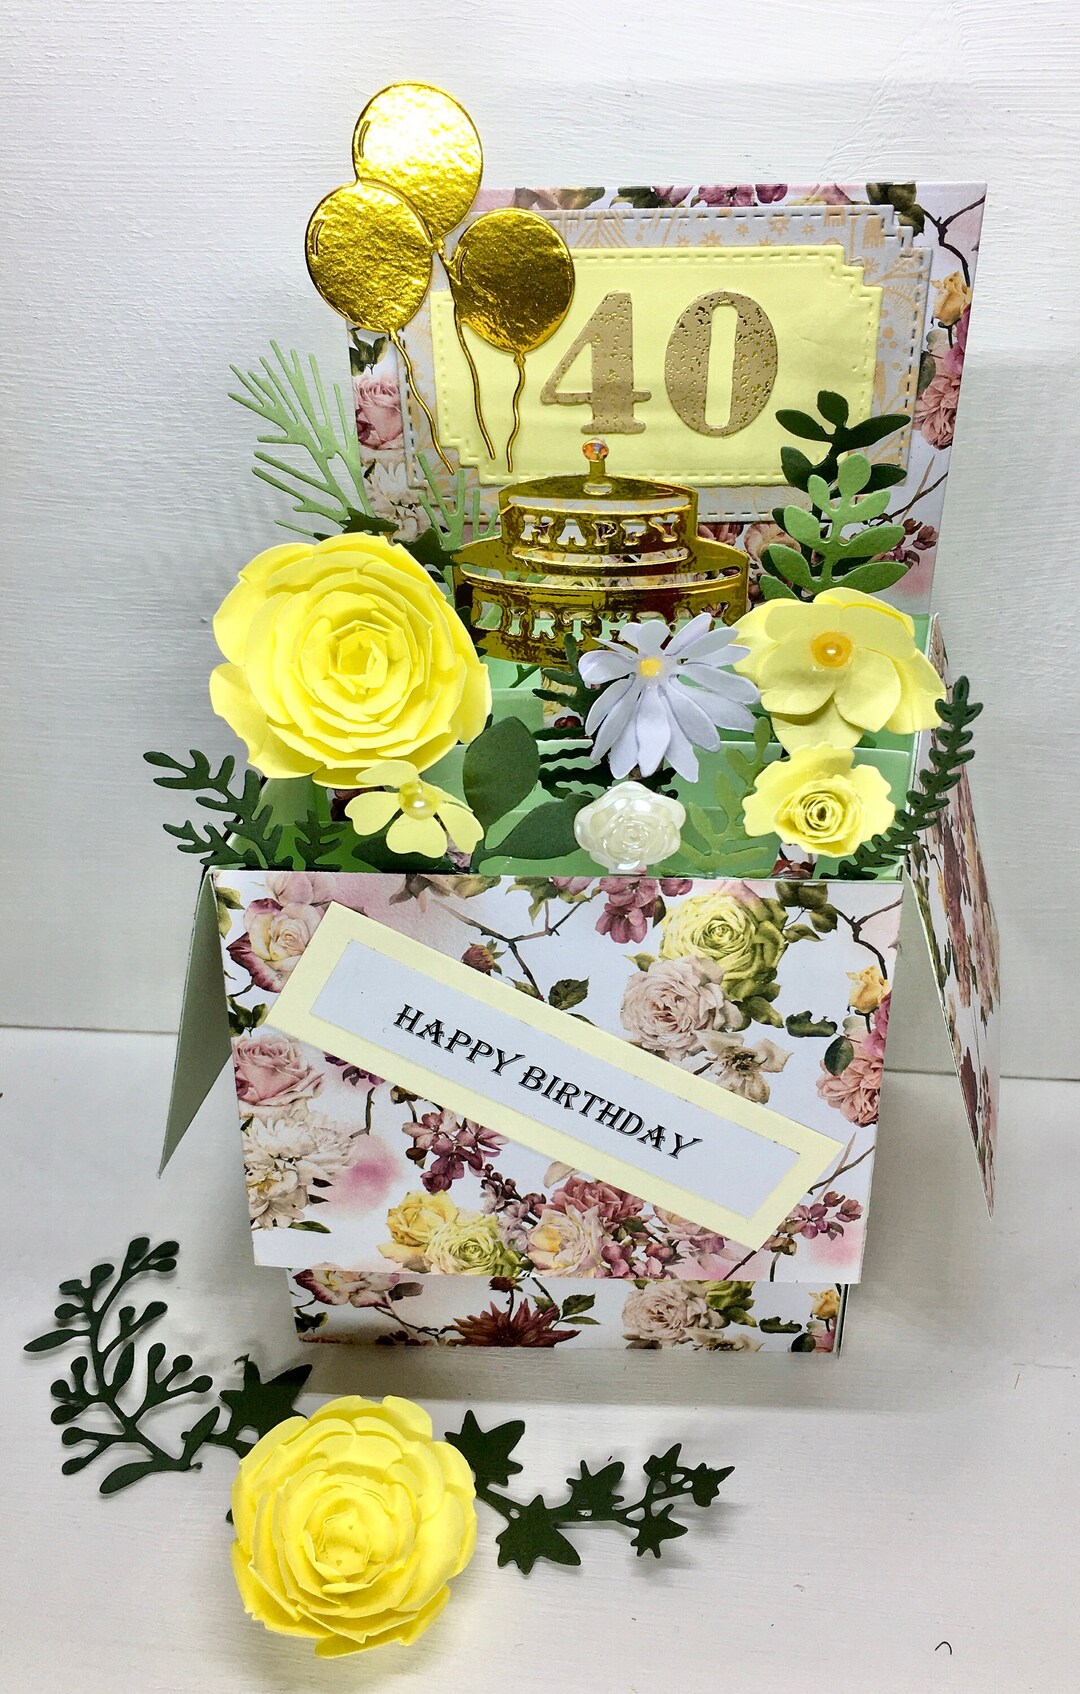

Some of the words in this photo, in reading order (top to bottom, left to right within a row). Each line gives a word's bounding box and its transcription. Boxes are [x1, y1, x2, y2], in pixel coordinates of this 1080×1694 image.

[540, 290, 778, 437] 40
[519, 514, 681, 547] HAPPY
[392, 1003, 526, 1077] HAPPY
[518, 1065, 704, 1160] BIRTHDAY
